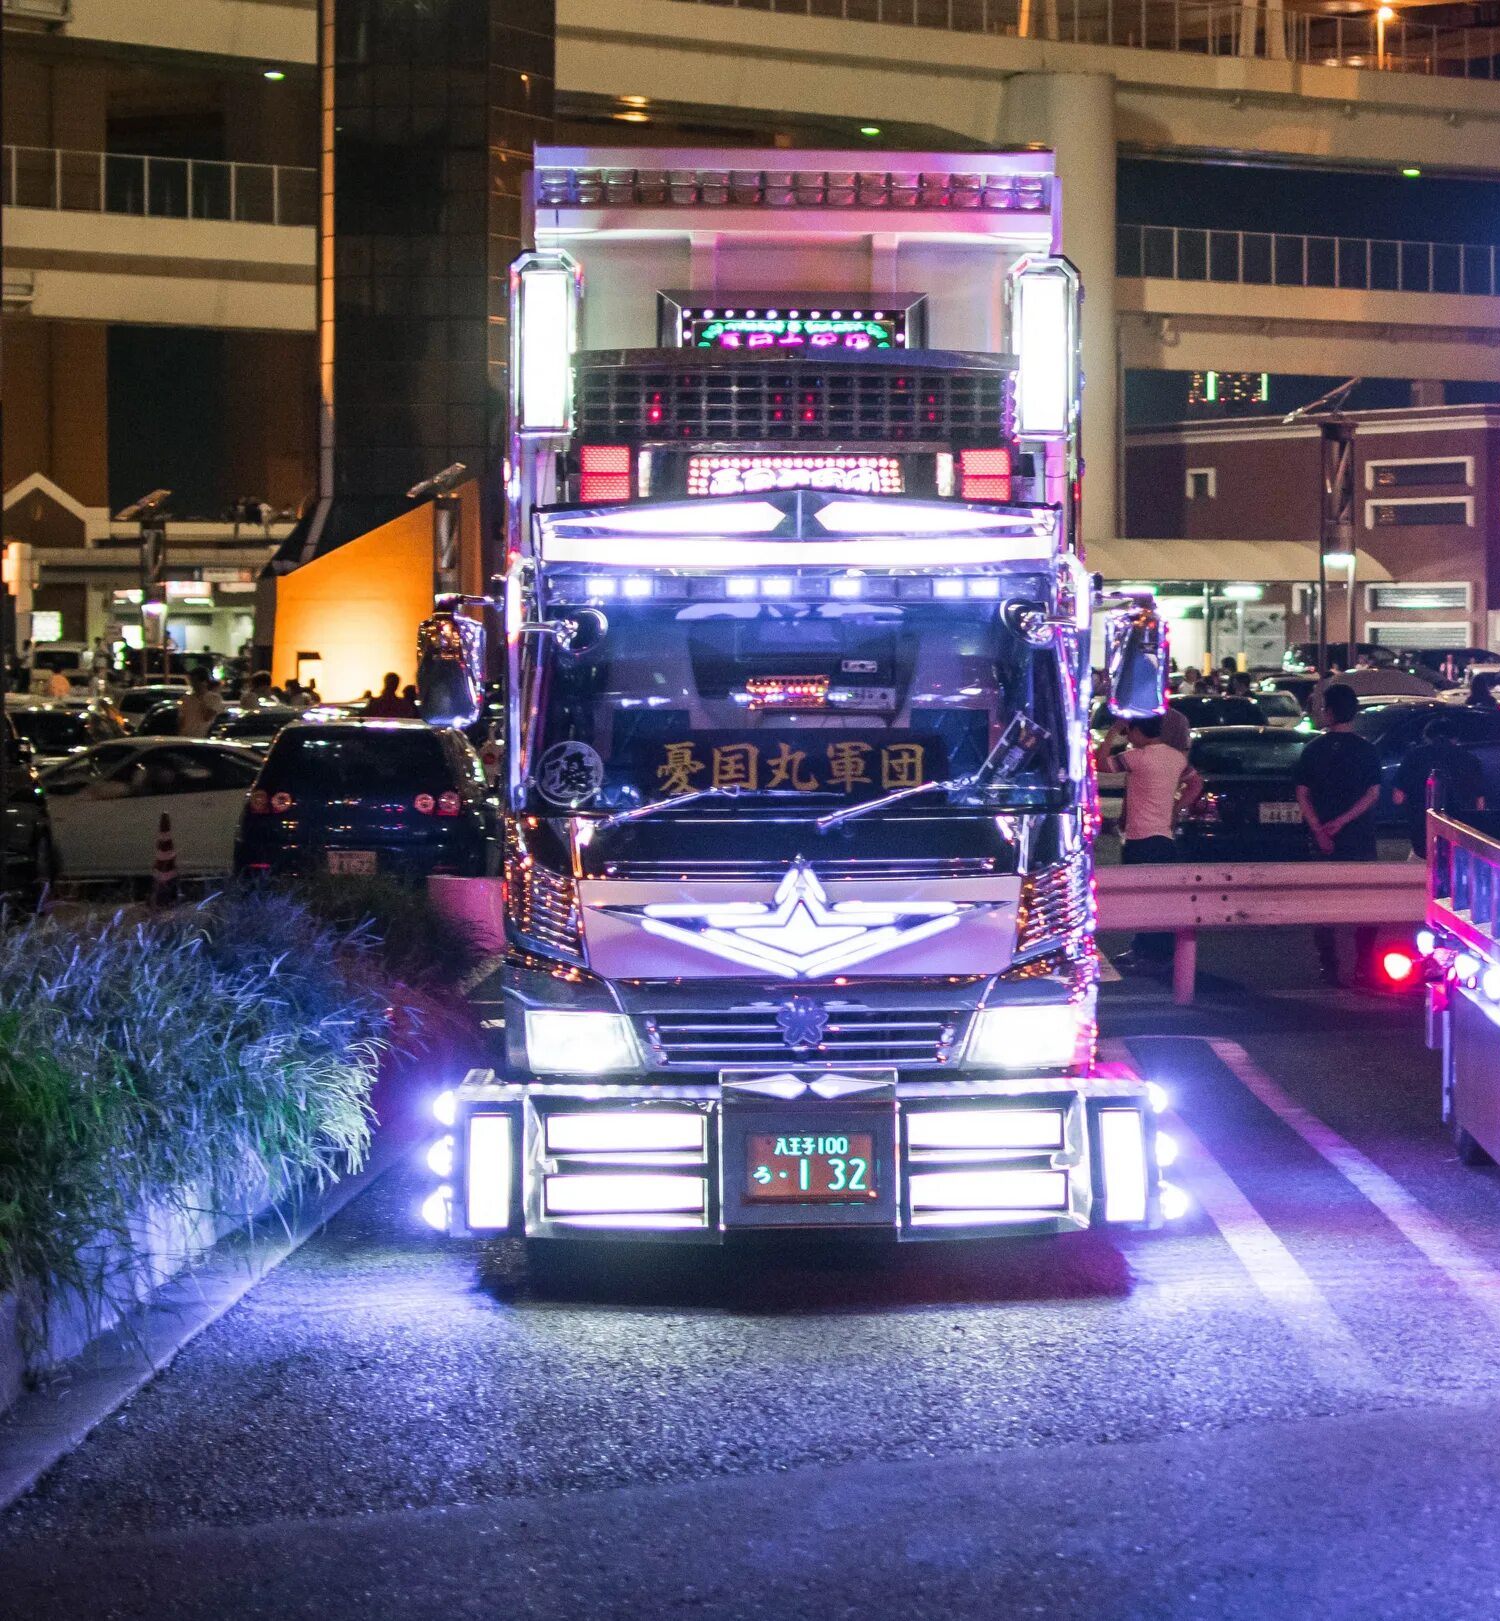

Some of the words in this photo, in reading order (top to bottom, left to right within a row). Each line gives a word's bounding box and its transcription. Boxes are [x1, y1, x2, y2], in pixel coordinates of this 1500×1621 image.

[657, 741, 924, 793] 憂国丸軍団
[774, 1137, 848, 1156] 八王子100
